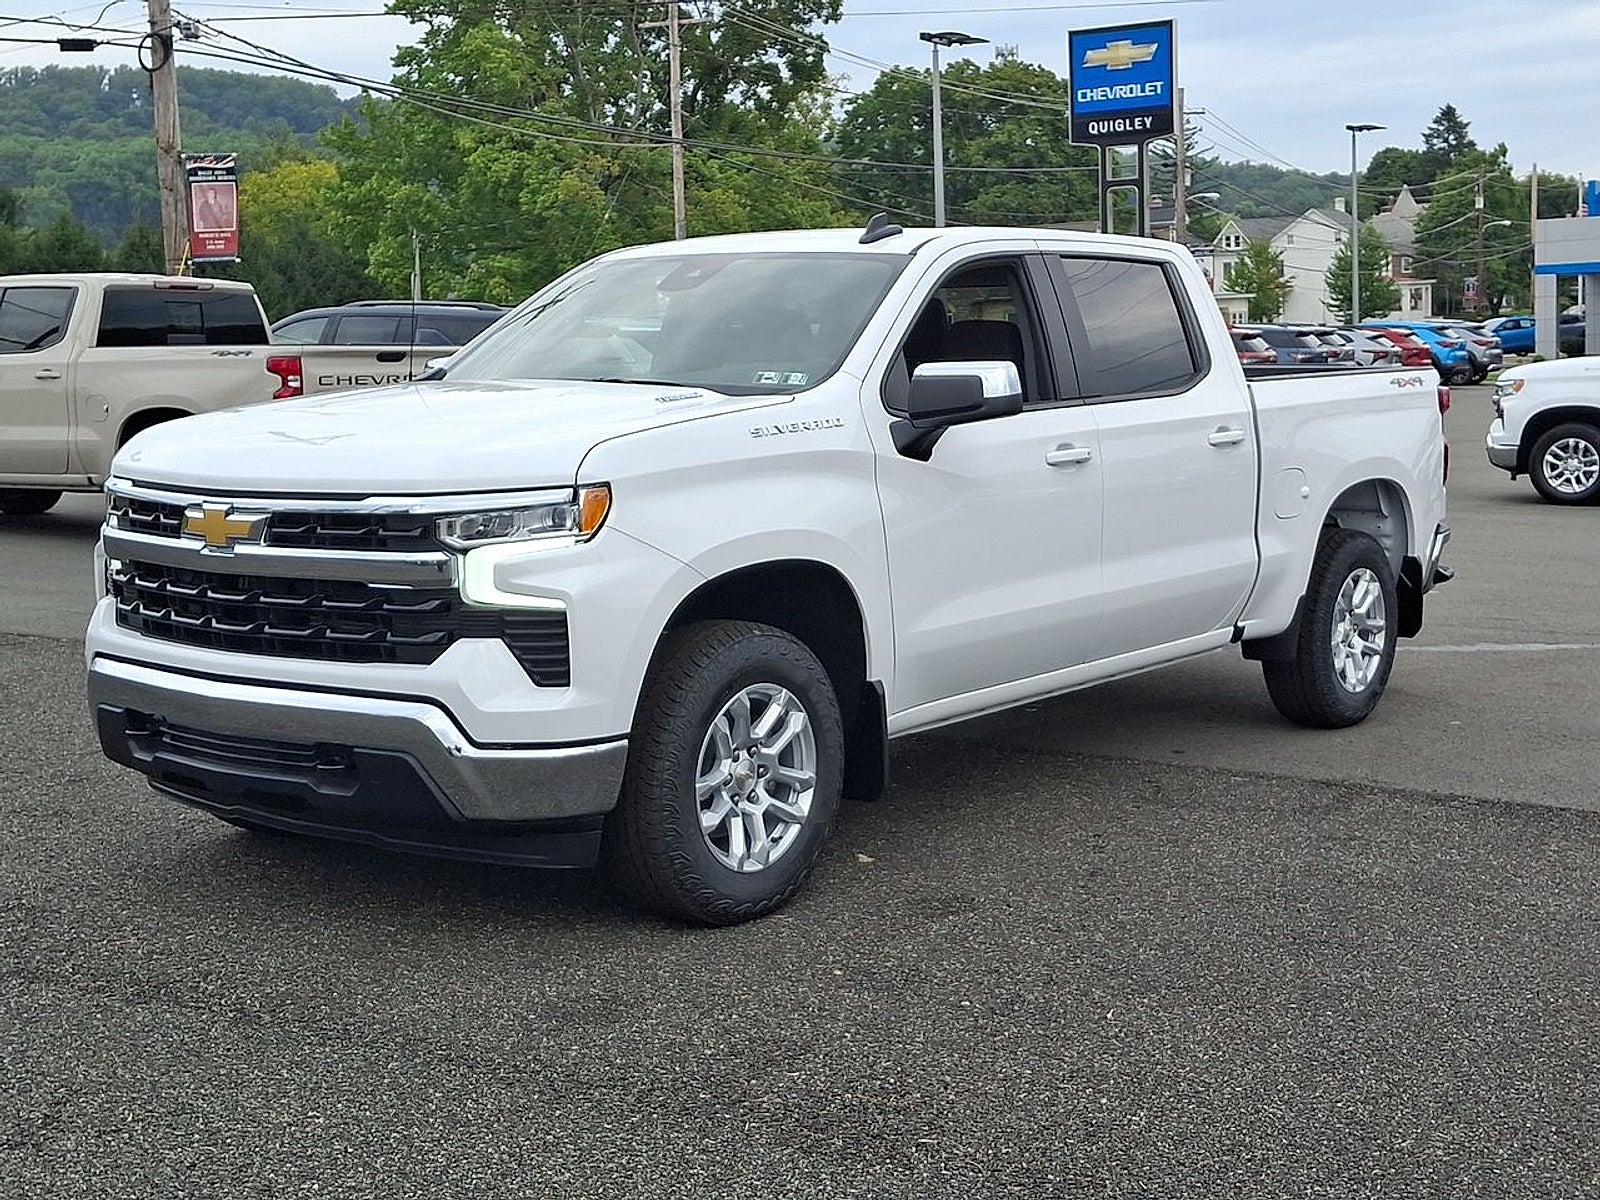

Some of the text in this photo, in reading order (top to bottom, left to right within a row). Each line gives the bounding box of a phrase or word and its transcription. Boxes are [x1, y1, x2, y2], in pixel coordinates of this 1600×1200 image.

[1077, 81, 1164, 102] CHEVROLET
[1088, 116, 1153, 135] QUIGLEY
[749, 417, 845, 438] SILVERADO
